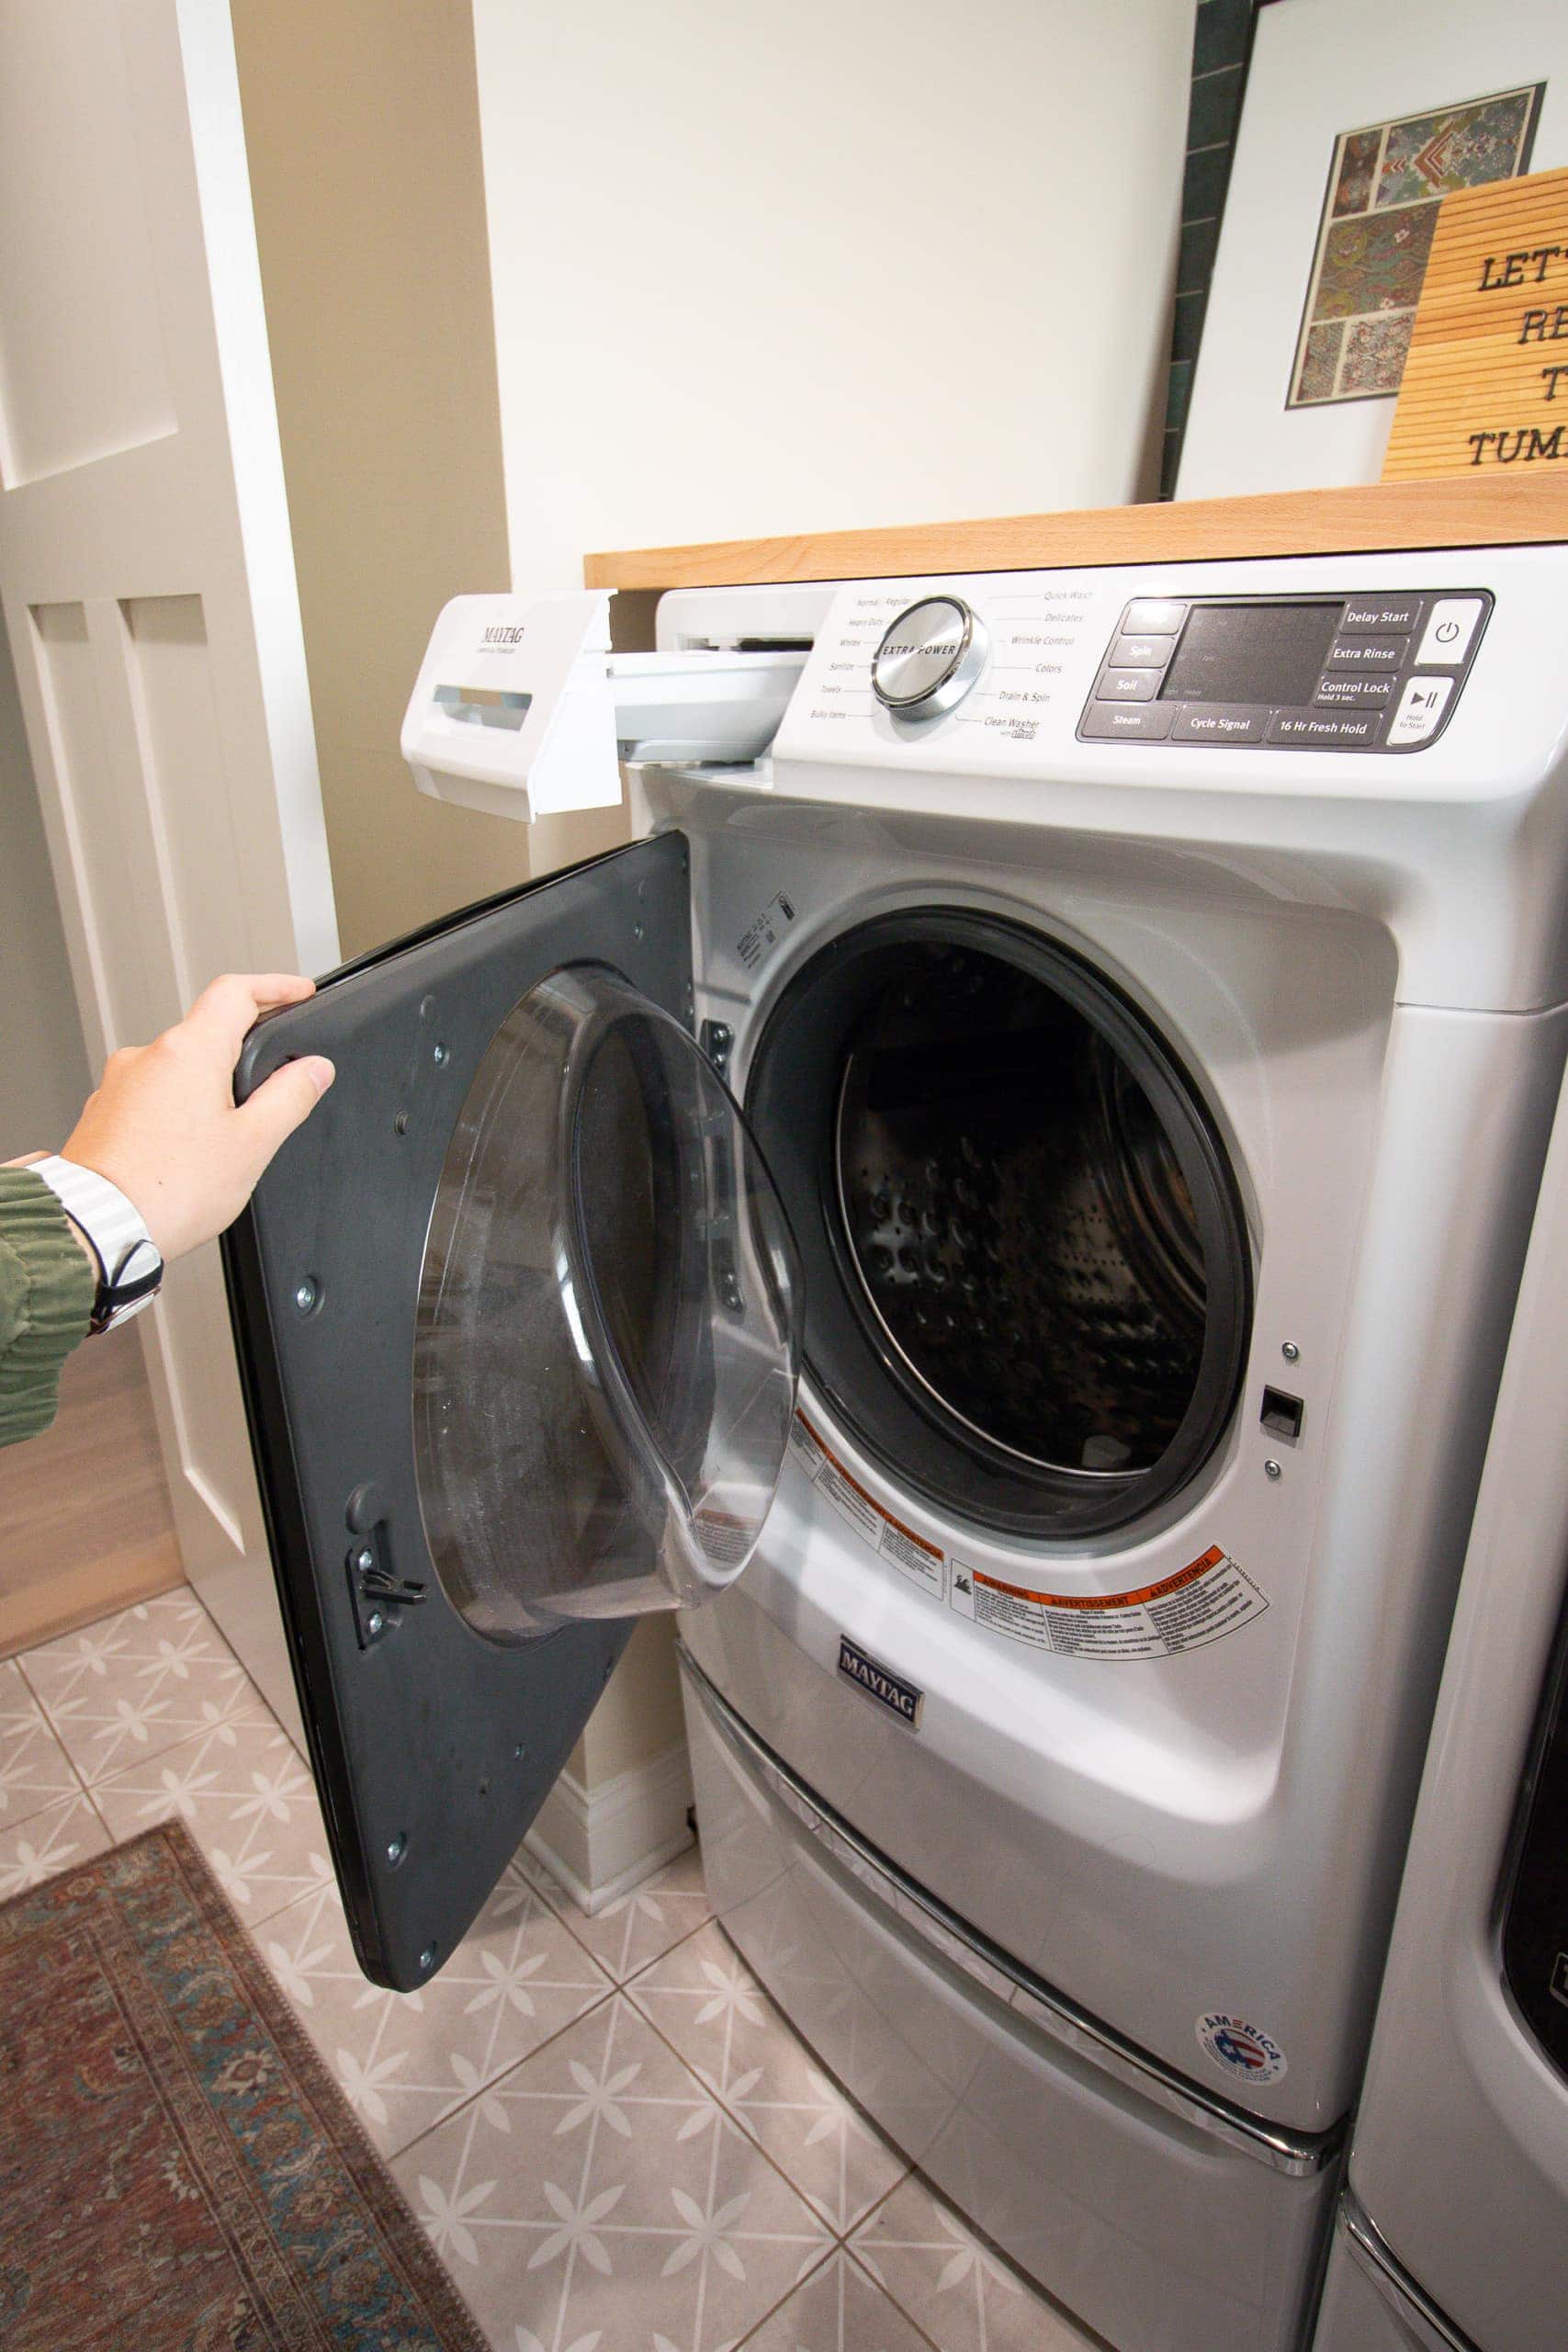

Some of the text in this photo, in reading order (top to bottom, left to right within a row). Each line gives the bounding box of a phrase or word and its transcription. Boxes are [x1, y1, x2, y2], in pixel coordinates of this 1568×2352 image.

[1469, 425, 1568, 466] TUM
[1044, 613, 1084, 623] Delicates
[1347, 611, 1410, 625] Delay Start
[1011, 636, 1075, 646] Wrinkle Control
[883, 645, 956, 655] EXTRA POWER
[1130, 645, 1153, 657] Spin
[1333, 648, 1396, 659] Extra Rinse
[1035, 662, 1063, 673] Colors
[1116, 679, 1138, 691] Soil
[1321, 681, 1391, 694] Control Lock
[998, 691, 1051, 703] Drain & Spin
[1317, 693, 1335, 701] Hold
[984, 716, 1040, 729] Clean Washer
[1112, 715, 1142, 725] Steam
[1190, 717, 1250, 731] Cycle Signal
[1408, 721, 1426, 729] Start
[1280, 720, 1367, 734] 16 Hr Fresh Hold
[1156, 1557, 1212, 1595] ADVERTENCIA
[840, 1651, 914, 1716] MAYTAG
[1204, 2014, 1281, 2061] AMERICA
